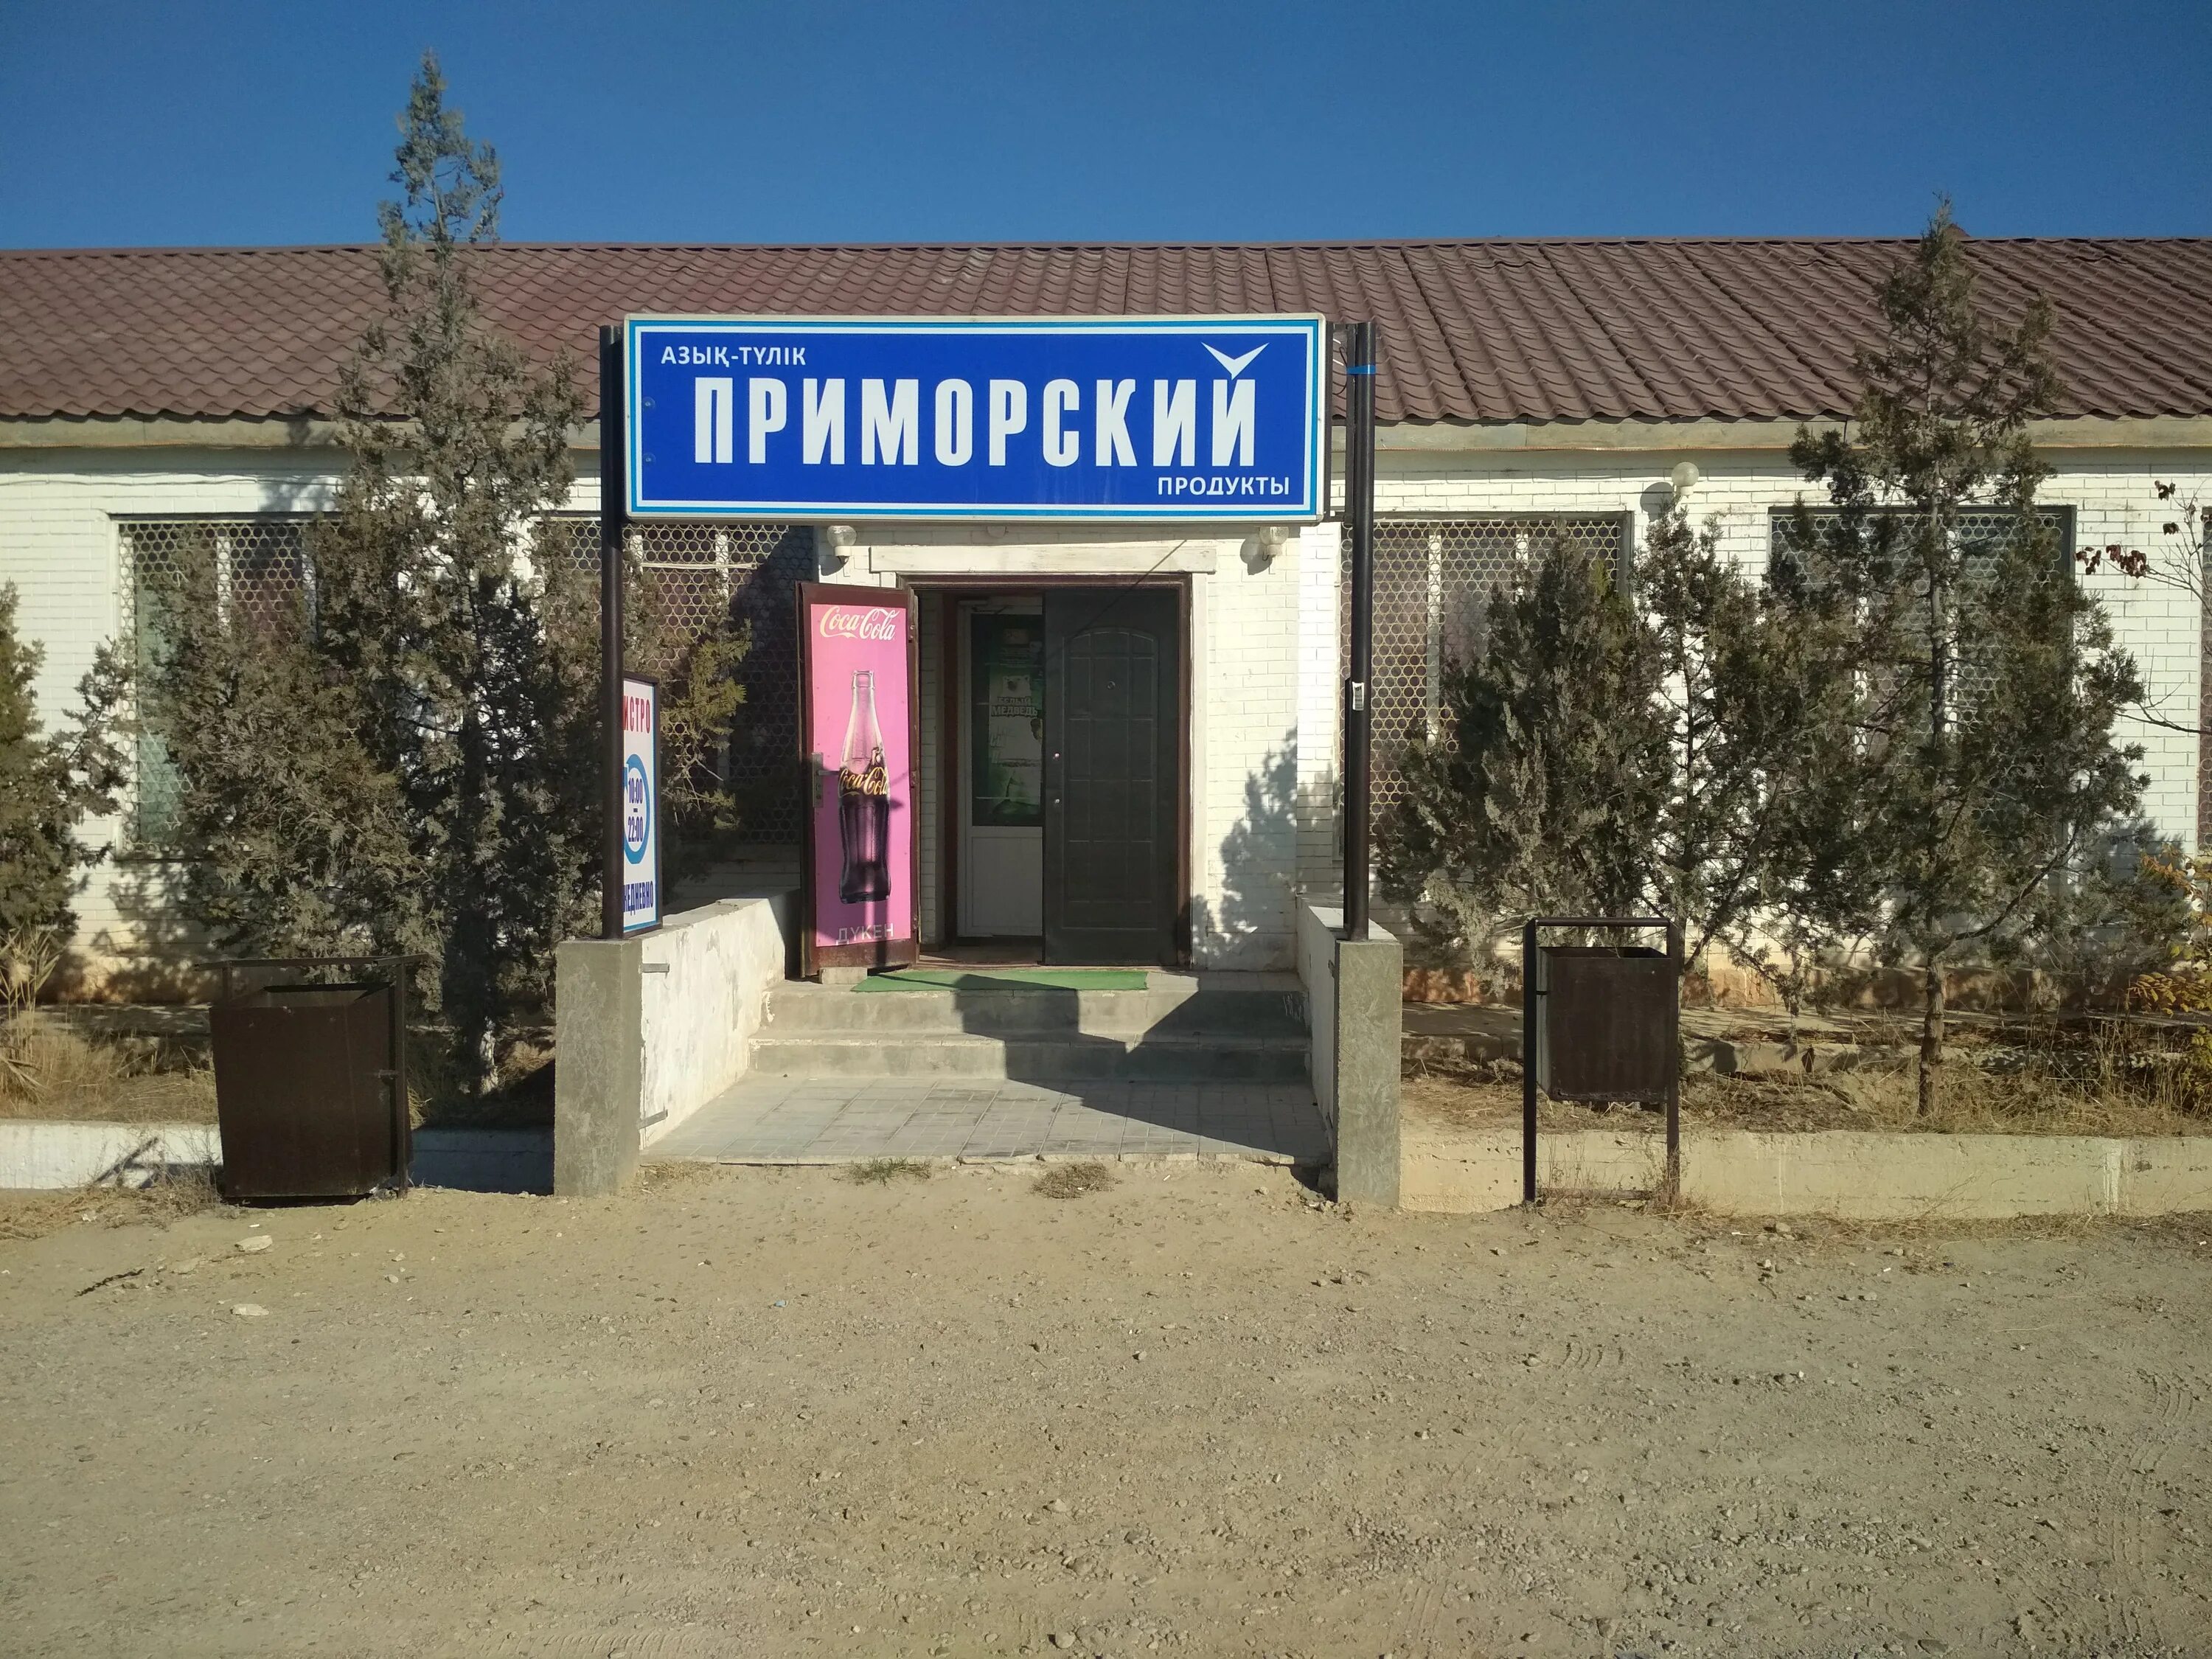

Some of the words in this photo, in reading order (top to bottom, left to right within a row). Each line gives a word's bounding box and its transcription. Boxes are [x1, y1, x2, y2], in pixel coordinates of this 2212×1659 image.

[661, 346, 806, 368] АЗЫҚ-ТҮЛІК
[695, 342, 1270, 468] ПРИМОРСКИЙ
[1158, 476, 1290, 495] ПРОДУКТЫ
[820, 606, 900, 641] Coca-Cola
[624, 695, 650, 734] ИСТРО
[992, 706, 1038, 716] МЕДВЕДЬ
[628, 778, 643, 804] 10:00
[628, 816, 643, 842] 22:00
[624, 880, 654, 916] ЕДНЕВНО
